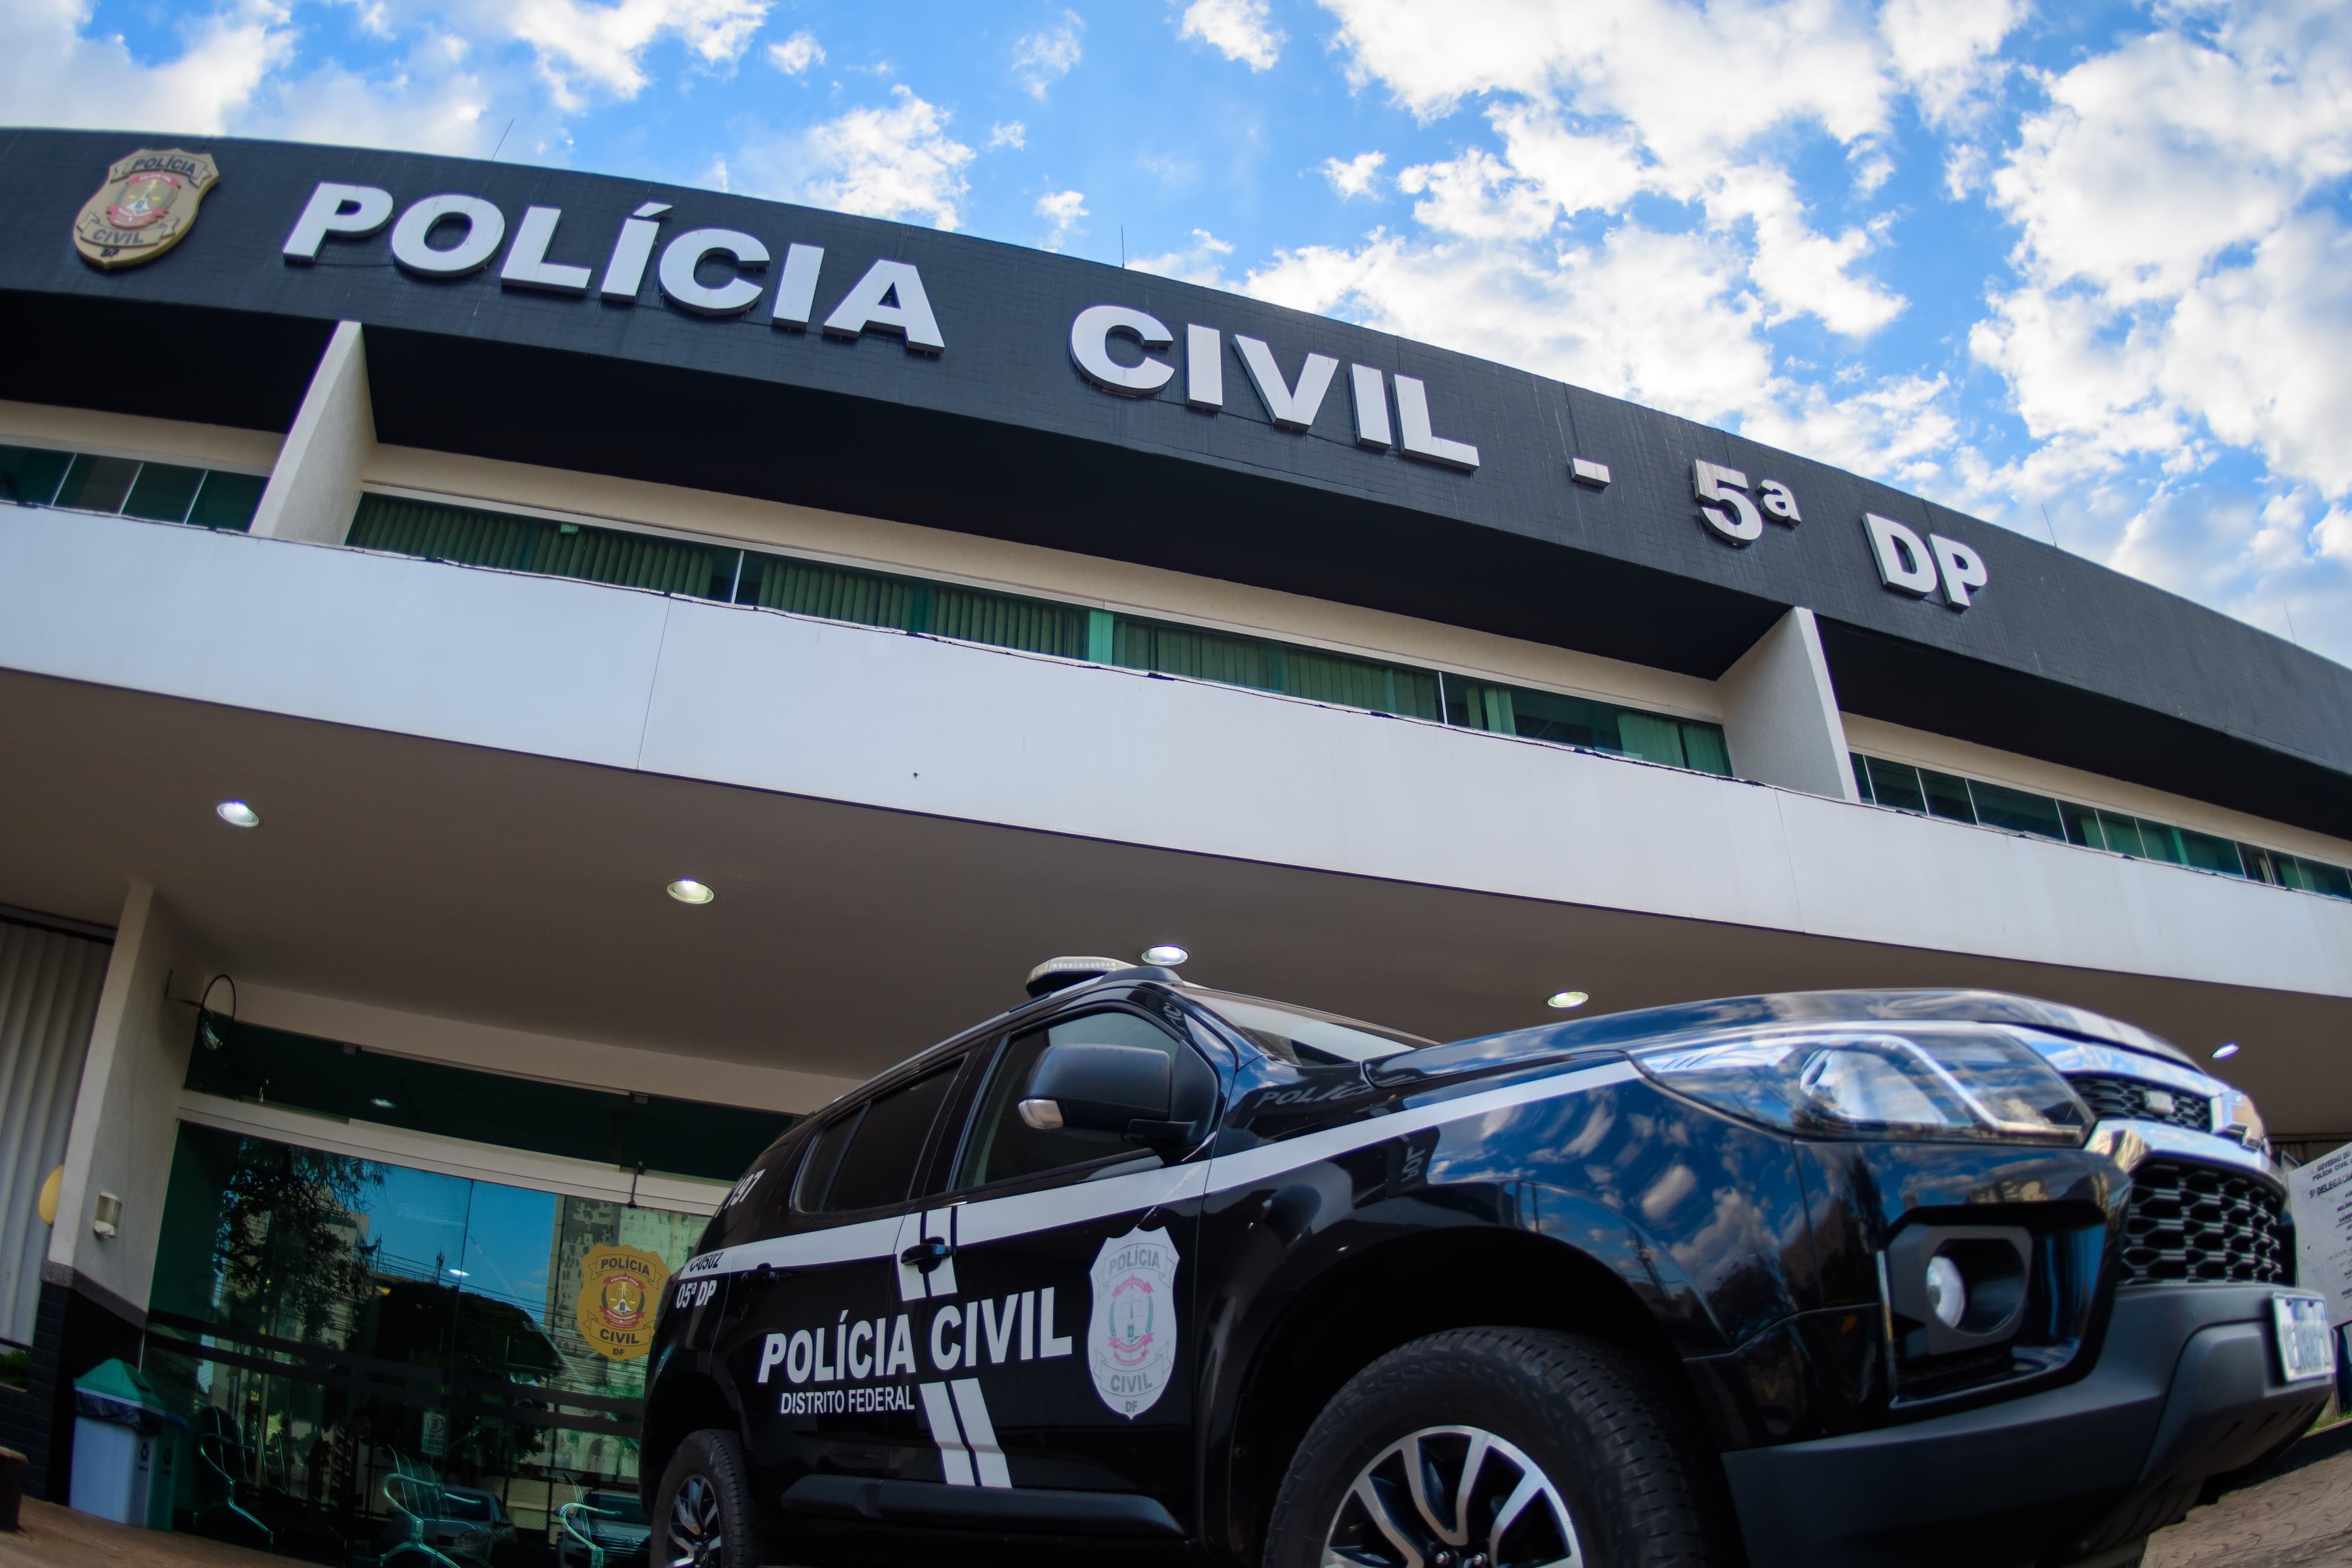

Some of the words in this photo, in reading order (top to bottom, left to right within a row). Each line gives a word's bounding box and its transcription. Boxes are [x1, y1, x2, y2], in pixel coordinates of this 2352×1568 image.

[132, 156, 196, 175] POLÍCIA
[93, 229, 144, 244] CIVIL
[282, 182, 945, 355] POLÍCIA
[1069, 305, 1480, 471] CIVIL
[1862, 512, 1987, 610] DP
[2317, 1155, 2341, 1172] GOVERNO
[2334, 1161, 2348, 1171] CIVIL
[600, 1256, 650, 1276] POLÍCIA
[1108, 1245, 1160, 1276] POLÍCIA
[696, 1279, 717, 1306] DP
[600, 1328, 640, 1345] CIVIL
[758, 1309, 916, 1383] POLÍCIA
[931, 1287, 1073, 1370] CIVIL
[613, 1348, 625, 1356] DF
[1111, 1372, 1153, 1393] CIVIL
[781, 1389, 844, 1414] DISTRITO
[848, 1385, 915, 1412] FEDERAL
[1125, 1400, 1138, 1412] DF
